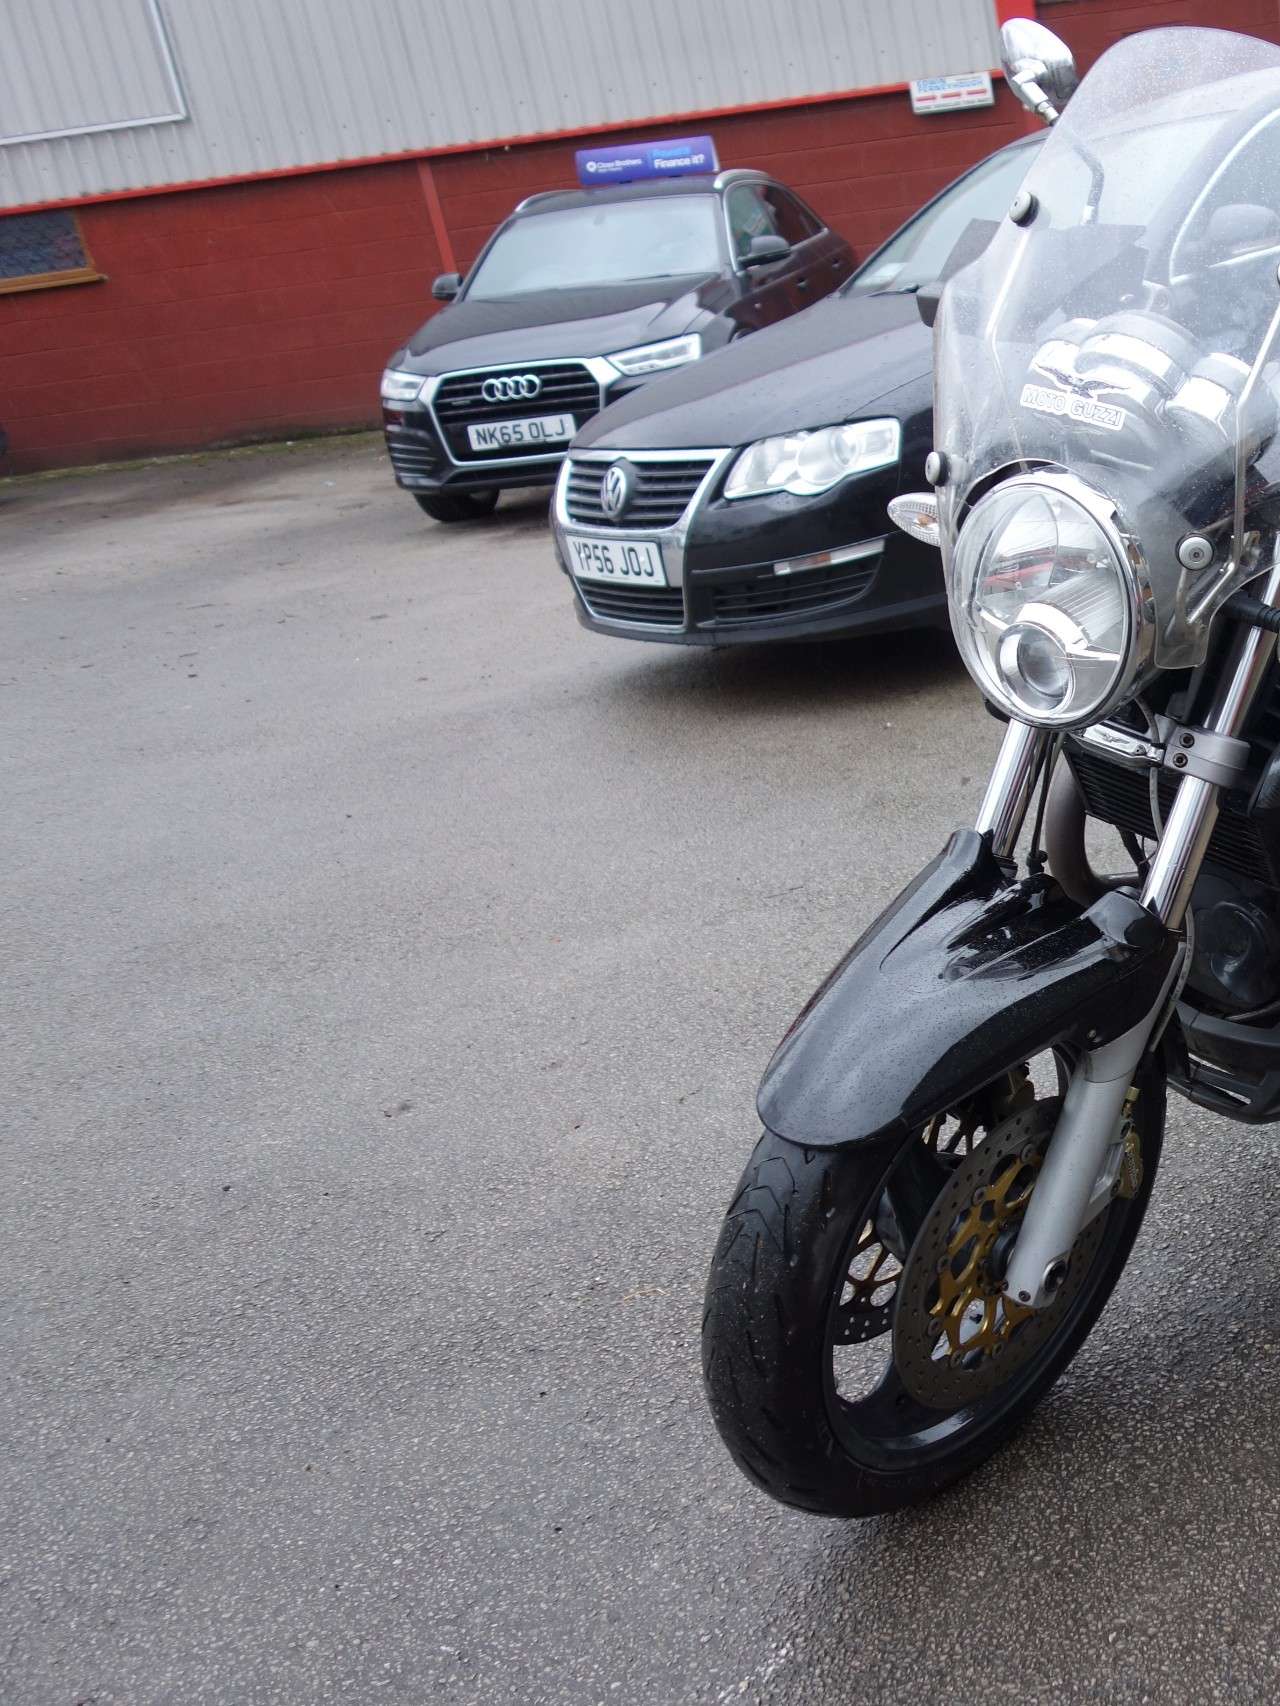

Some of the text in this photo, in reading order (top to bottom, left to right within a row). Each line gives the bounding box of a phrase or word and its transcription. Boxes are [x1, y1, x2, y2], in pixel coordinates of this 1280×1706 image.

[653, 157, 690, 169] Finance
[1022, 389, 1122, 427] MOTO GUZZI
[475, 418, 566, 445] NK65 OLJ
[572, 541, 655, 577] YP56 JOJ
